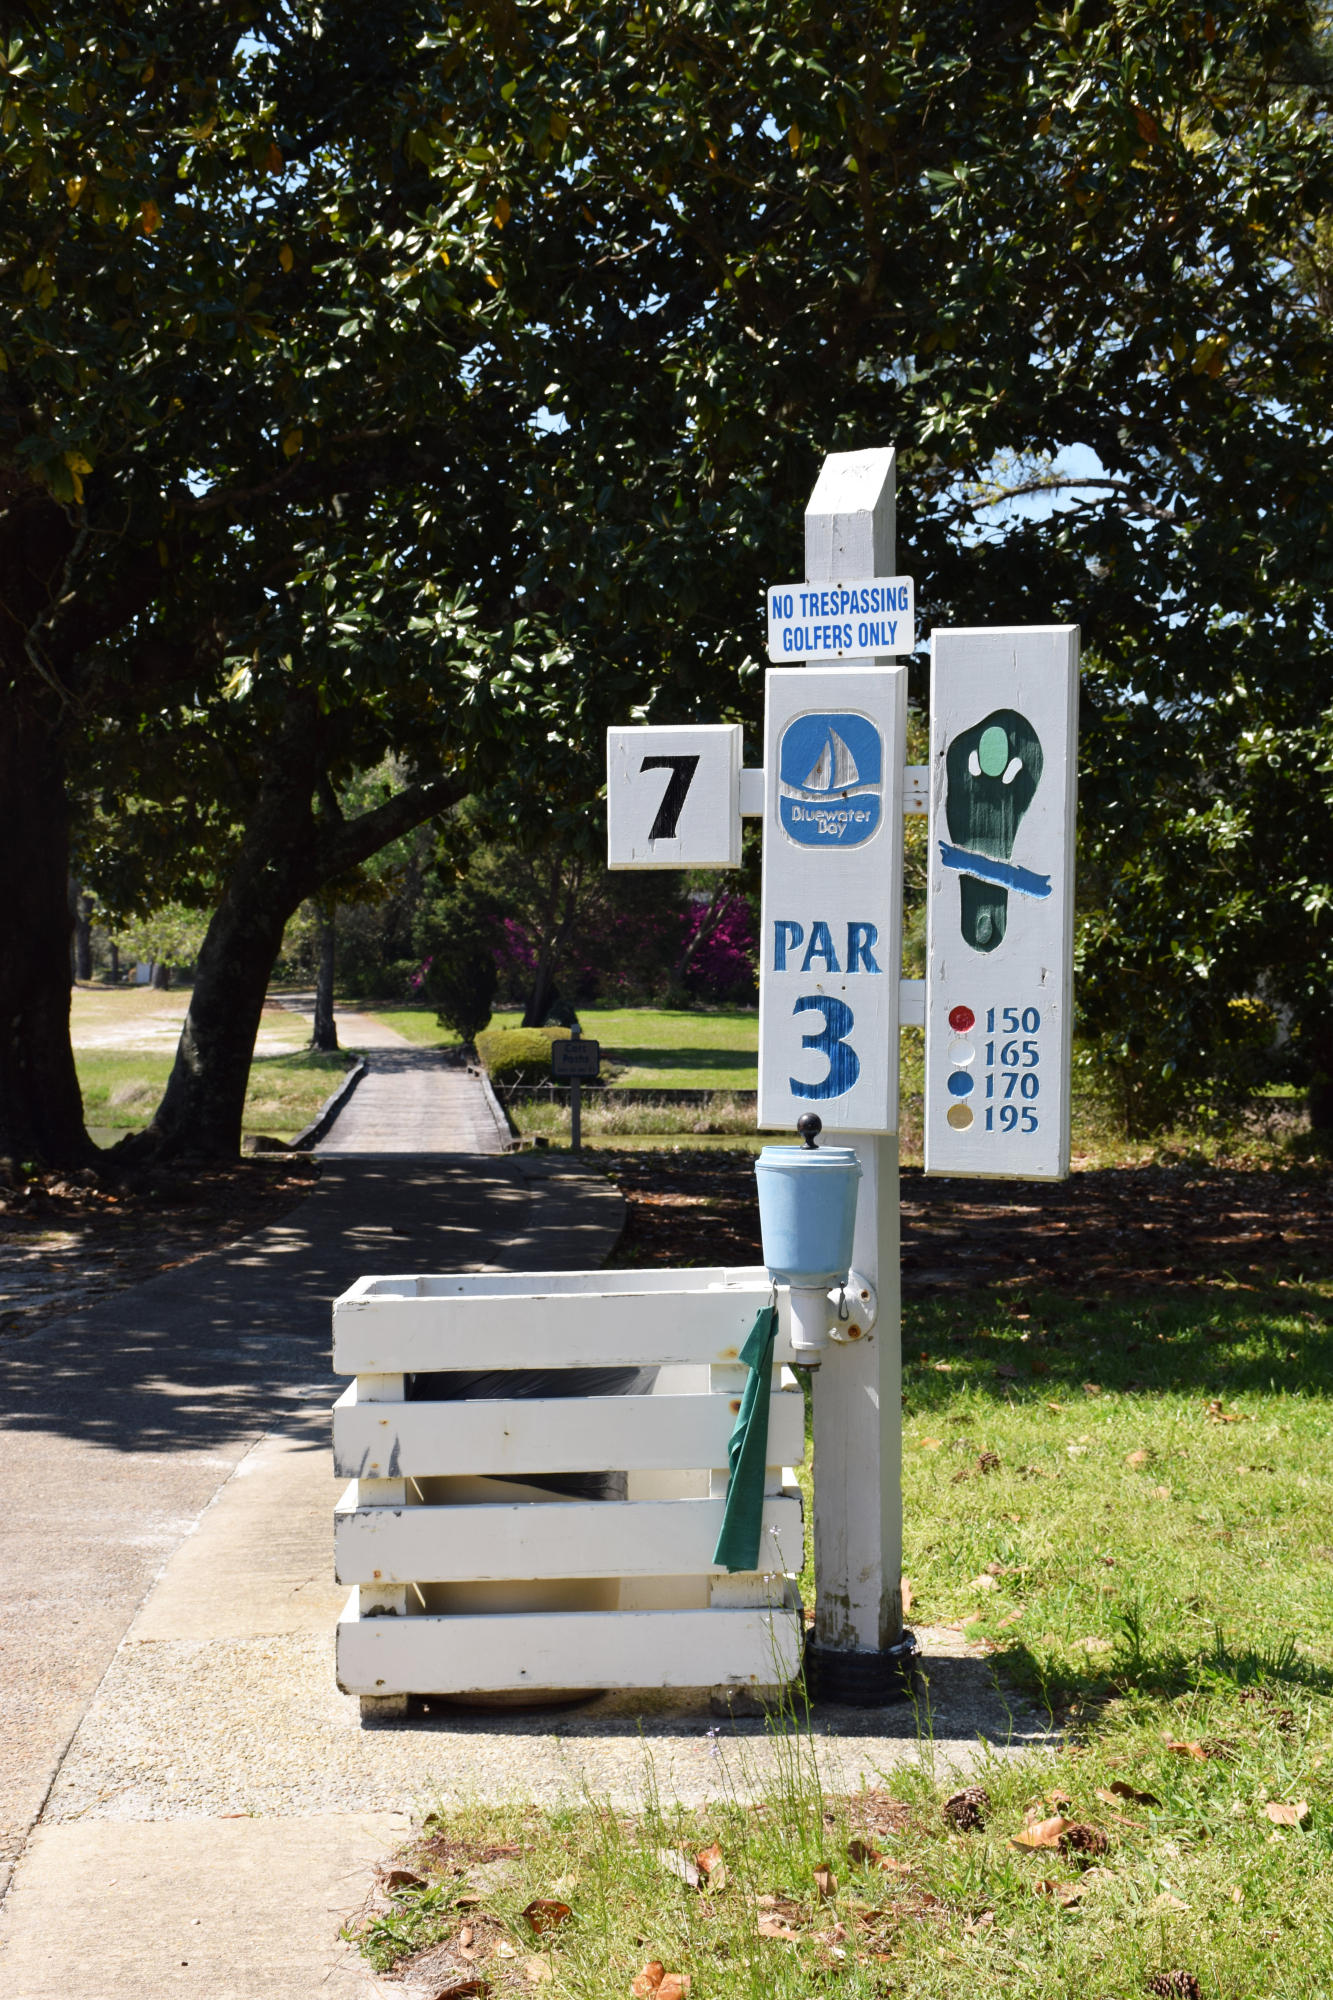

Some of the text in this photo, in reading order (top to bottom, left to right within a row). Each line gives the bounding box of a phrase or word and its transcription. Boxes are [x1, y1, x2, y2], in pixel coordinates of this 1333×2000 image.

[772, 586, 908, 619] NO TRESPASSING
[783, 621, 898, 652] GOLFERS ONLY
[640, 755, 700, 839] 7
[773, 920, 883, 974] PAR
[985, 1007, 1041, 1034] 150
[789, 995, 860, 1100] 3
[984, 1040, 1039, 1068] 165
[984, 1072, 1039, 1100] 170
[984, 1105, 1039, 1133] 195
